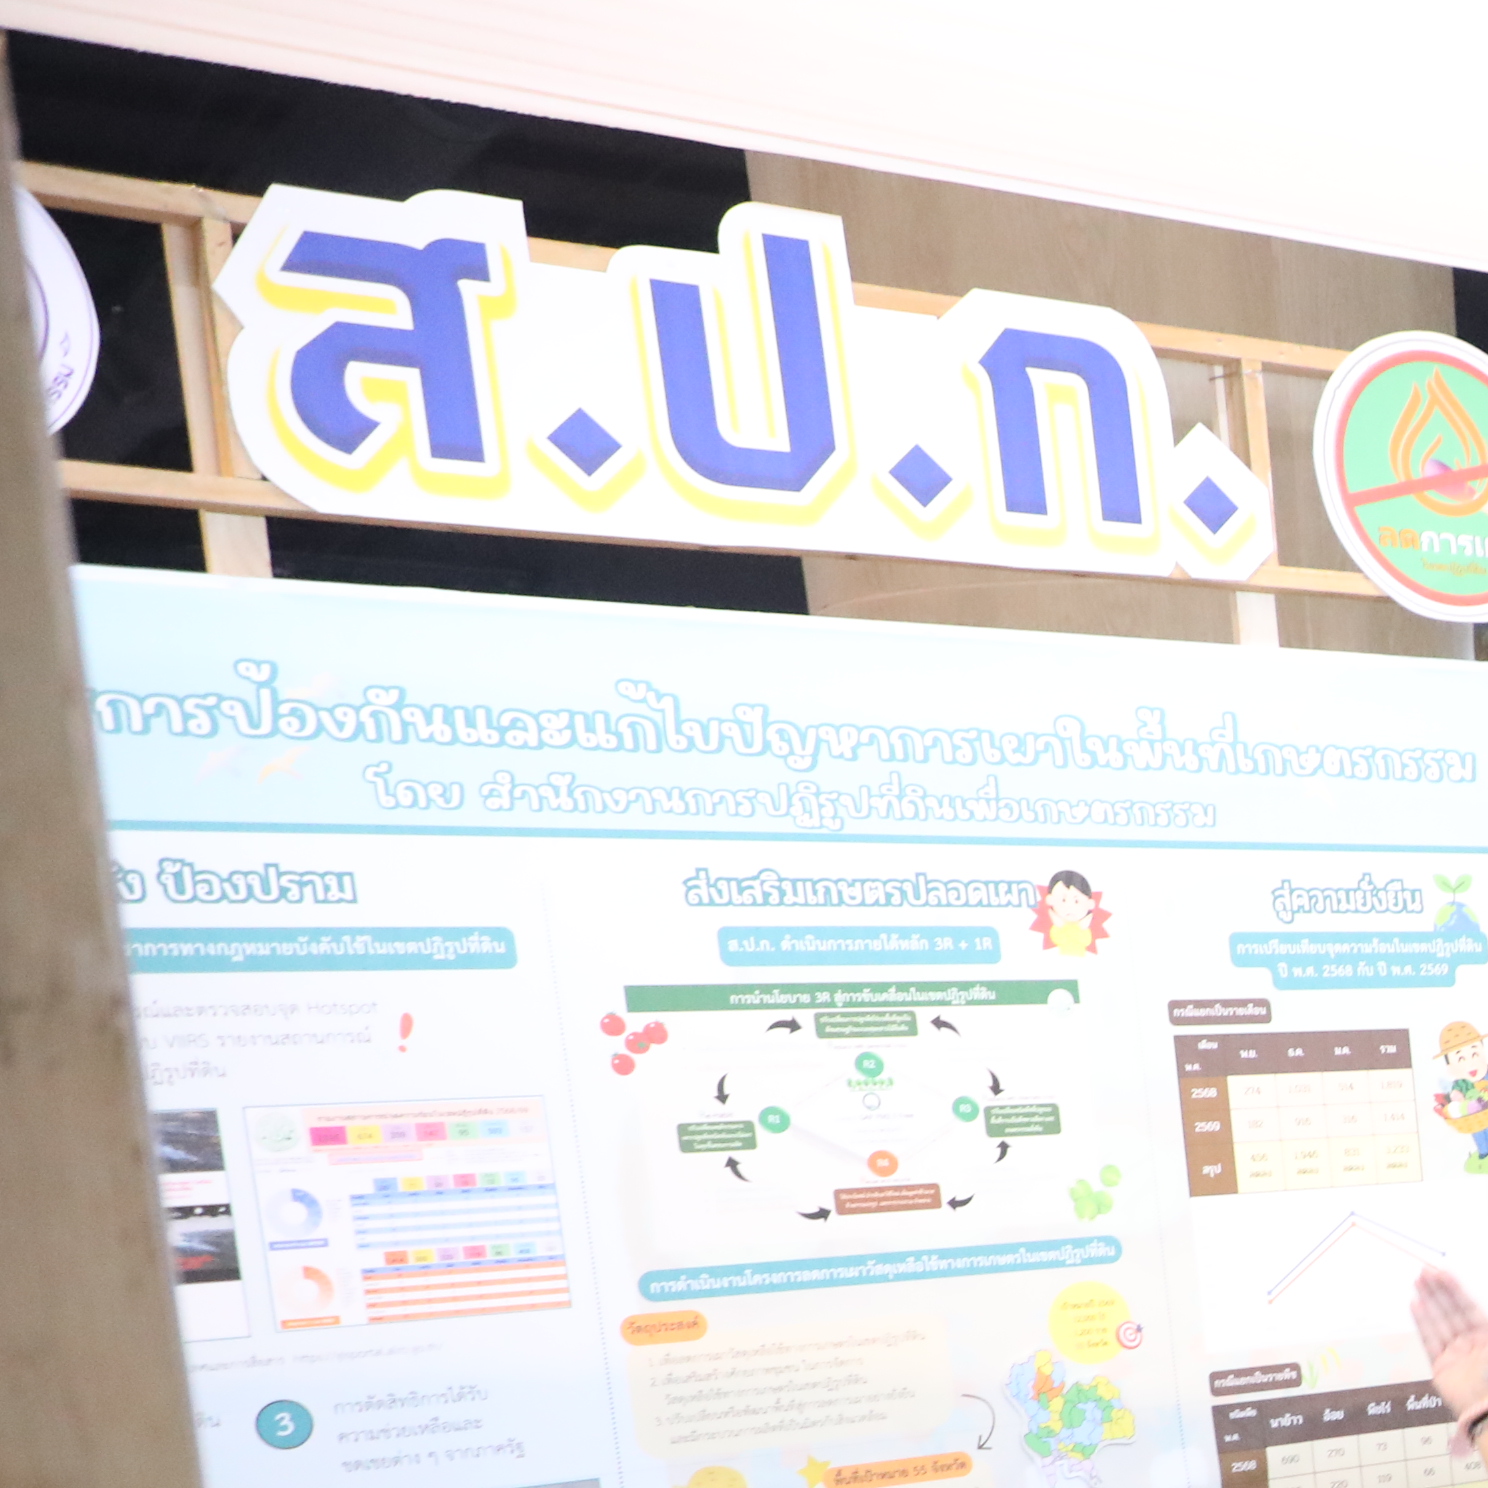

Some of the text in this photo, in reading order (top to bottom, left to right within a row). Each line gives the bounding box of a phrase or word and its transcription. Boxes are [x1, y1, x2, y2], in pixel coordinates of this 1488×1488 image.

[270, 228, 1248, 545] ส.ป.ก.
[363, 762, 1218, 832] โดย สำนักงานการปฏิรูปที่ดินเพื่อเกษตรกรรม
[157, 857, 359, 904] ป้องปราม
[683, 866, 1038, 909] ส่งเสริมเกษตรปลอดเผา
[1271, 871, 1424, 925] สู่ความยั่งยืน
[726, 934, 775, 953] ส.ป.ก.
[780, 931, 929, 952] ดำเนินการภายใต้หลัก
[933, 936, 954, 951] 3R
[972, 935, 992, 951] 1R
[1278, 961, 1288, 979] ปี
[1322, 962, 1353, 978] 2568
[1357, 959, 1374, 977] กับ
[1377, 960, 1388, 977] ปี
[1420, 962, 1449, 977] 2569
[306, 1000, 379, 1018] Hotspot
[813, 991, 831, 1004] 3R
[143, 1060, 228, 1088] ฏิรูปที่ดิน
[1191, 1087, 1218, 1099] 2568
[274, 1412, 296, 1436] 3
